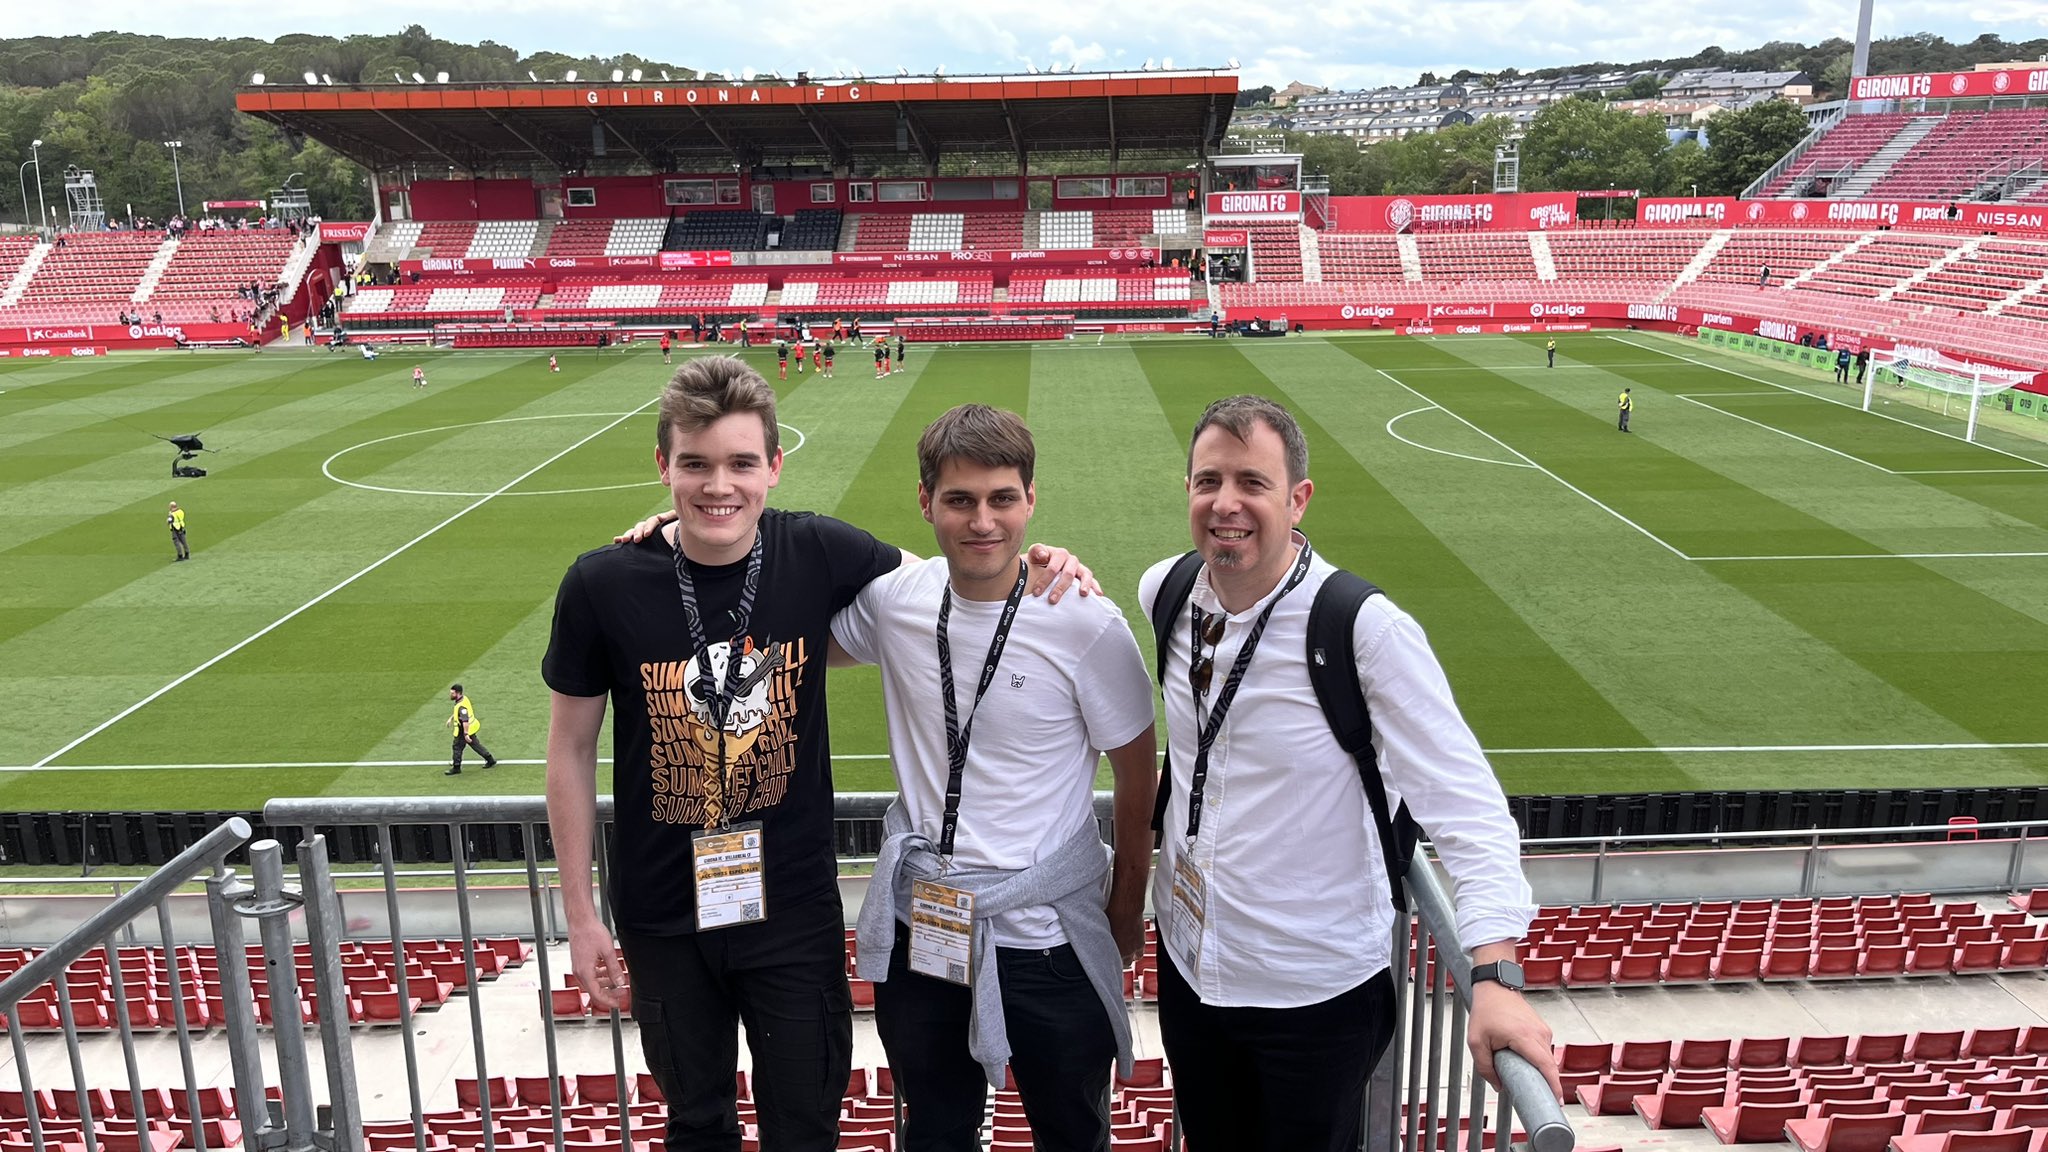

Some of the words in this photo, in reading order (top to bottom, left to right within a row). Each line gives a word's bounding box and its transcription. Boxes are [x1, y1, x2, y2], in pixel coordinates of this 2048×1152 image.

[1857, 77, 1910, 98] GIRONA
[1912, 75, 1932, 95] FC
[587, 90, 760, 103] GIRONA
[817, 87, 860, 100] FC
[1221, 195, 1268, 212] GIRONA
[1270, 194, 1287, 211] FC
[1421, 204, 1472, 220] GIRONA
[1474, 203, 1493, 221] FC
[1645, 203, 1702, 221] GIRONA
[1705, 203, 1725, 221] FC
[1828, 203, 1878, 221] GIRONA
[1880, 203, 1899, 224] FC
[1976, 211, 2043, 226] NISSAN
[323, 228, 363, 238] FRISELVA
[550, 258, 576, 267] Gosbi
[951, 251, 992, 260] PROGEN
[422, 259, 452, 271] GIRONA
[453, 259, 464, 270] FC
[1355, 305, 1394, 318] LaLiga
[1445, 306, 1488, 316] CaixaBank
[1545, 303, 1585, 317] LaLiga
[1627, 304, 1667, 321] GIRONA
[1667, 305, 1678, 322] FC
[1708, 312, 1733, 326] parlem
[45, 330, 87, 339] CaixaBank
[1456, 325, 1481, 334] Gosbi
[1759, 320, 1786, 340] GIRONA
[1786, 324, 1797, 342] FC
[1835, 333, 1861, 345] SISTEMAS
[2020, 398, 2032, 409] 019
